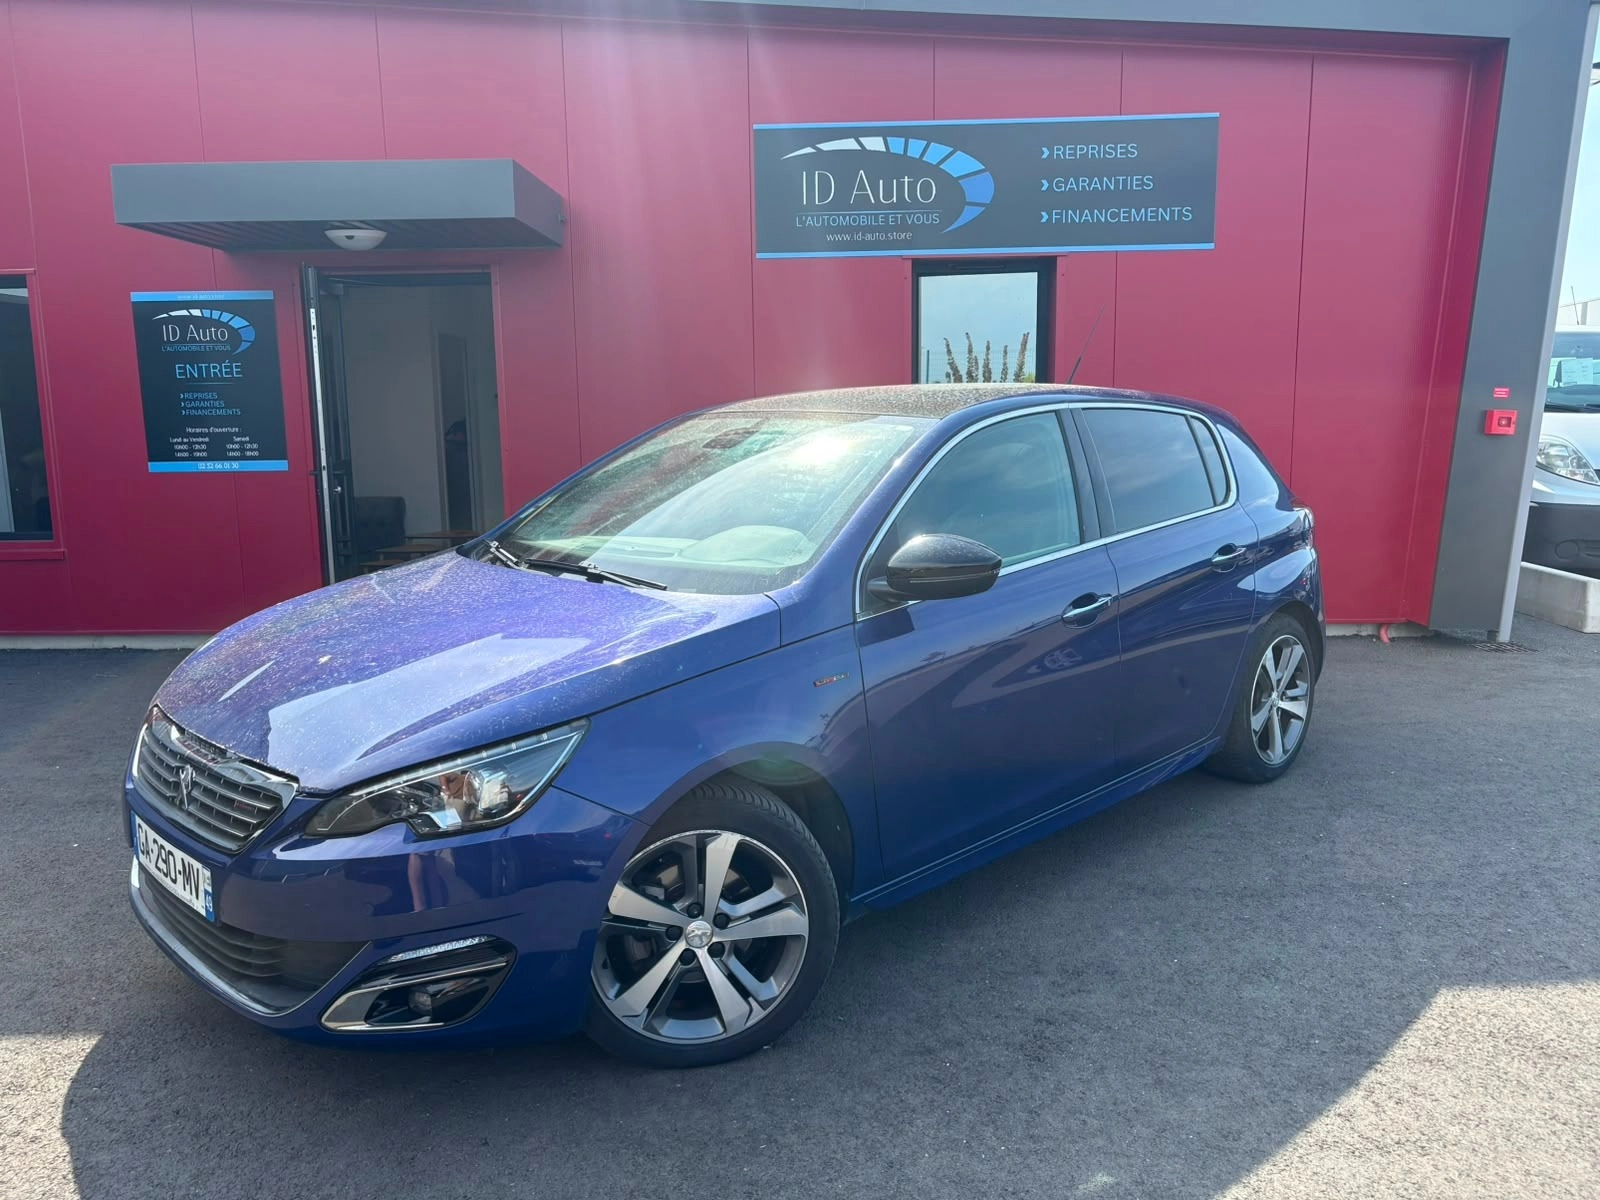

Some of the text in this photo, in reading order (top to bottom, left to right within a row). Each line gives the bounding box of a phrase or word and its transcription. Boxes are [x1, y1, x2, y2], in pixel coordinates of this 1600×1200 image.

[1053, 143, 1138, 160] REPRISES
[802, 169, 936, 205] ID Auto
[1052, 175, 1154, 192] GARANTIES
[796, 213, 940, 227] L'AUTOMOBILE ET VOUS
[1052, 206, 1193, 224] FINANCEMENTS
[826, 231, 912, 241] www.id-auto.store
[162, 324, 228, 342] ID Auto
[175, 360, 243, 379] ENTRÉE
[184, 392, 218, 400] REPRISES
[185, 400, 225, 408] GARANTIES
[185, 408, 241, 416] FINANCEMENTS
